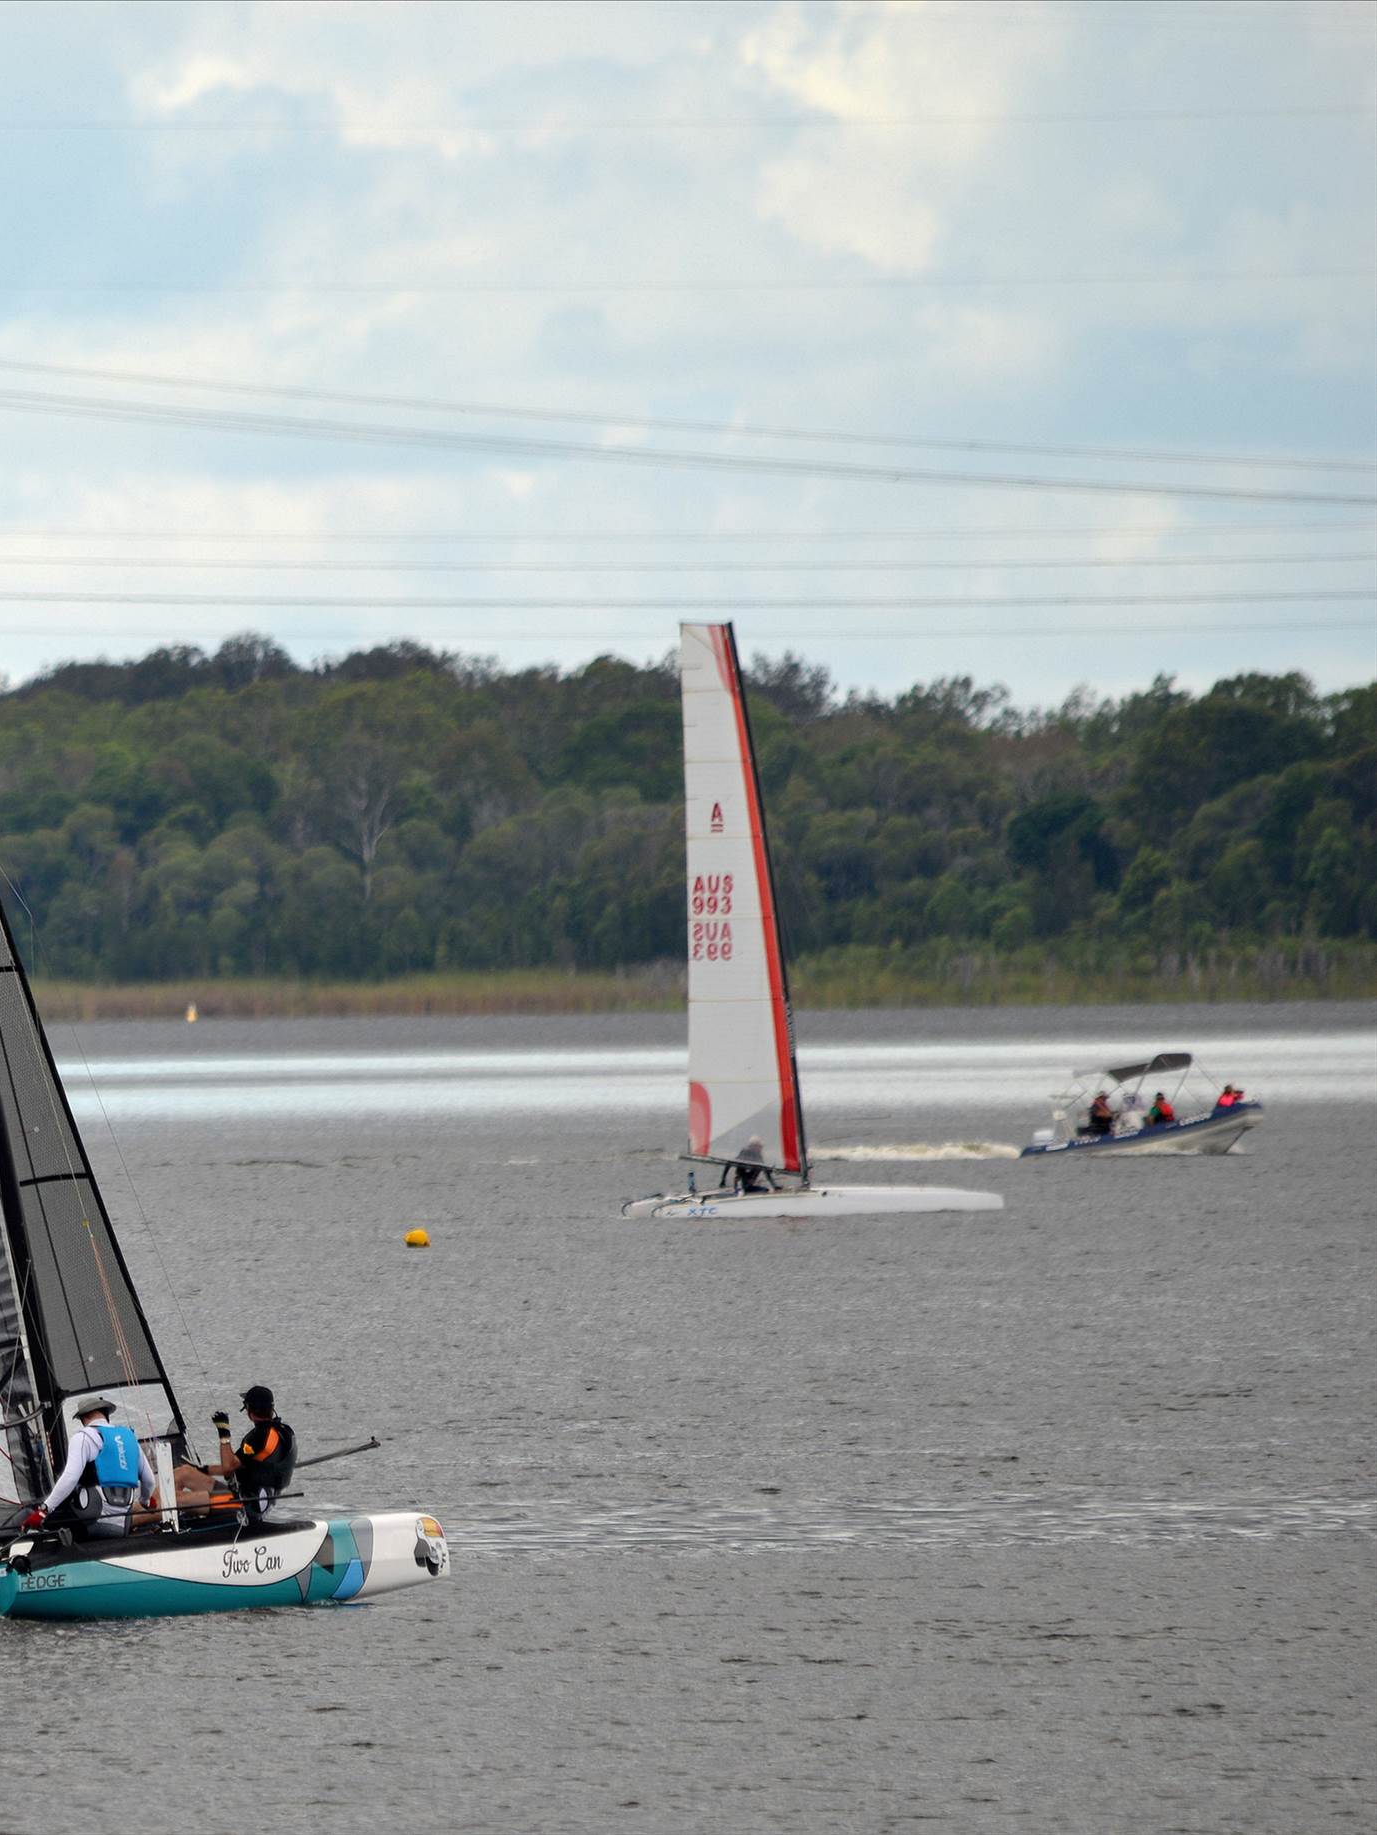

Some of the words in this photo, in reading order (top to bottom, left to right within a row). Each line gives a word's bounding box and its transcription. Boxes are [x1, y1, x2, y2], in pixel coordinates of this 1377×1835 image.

[693, 874, 733, 895] AUS
[692, 896, 733, 916] 993
[222, 1549, 251, 1578] Two
[254, 1546, 283, 1573] Can
